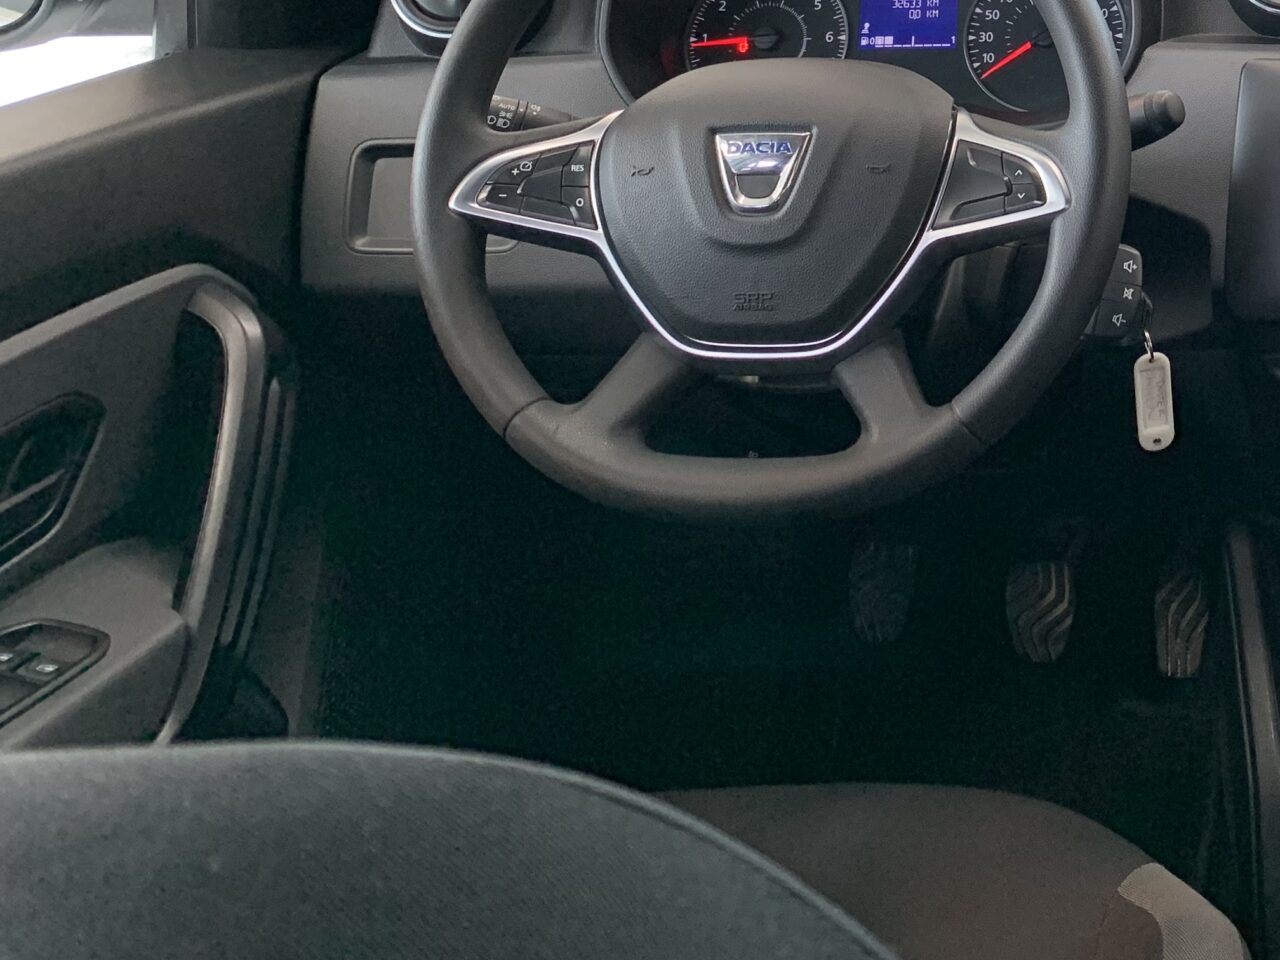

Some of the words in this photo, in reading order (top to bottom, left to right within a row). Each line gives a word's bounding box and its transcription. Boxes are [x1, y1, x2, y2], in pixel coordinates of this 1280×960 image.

[718, 0, 726, 12] 2
[814, 0, 822, 11] 5
[892, 0, 922, 8] 32633
[926, 0, 939, 7] KM
[926, 9, 939, 18] KM
[985, 9, 1000, 20] 50
[825, 31, 834, 43] 6
[978, 31, 994, 42] 30
[982, 52, 995, 63] 10
[499, 103, 516, 111] AUTO
[725, 141, 794, 155] DACIA
[570, 164, 585, 172] RES
